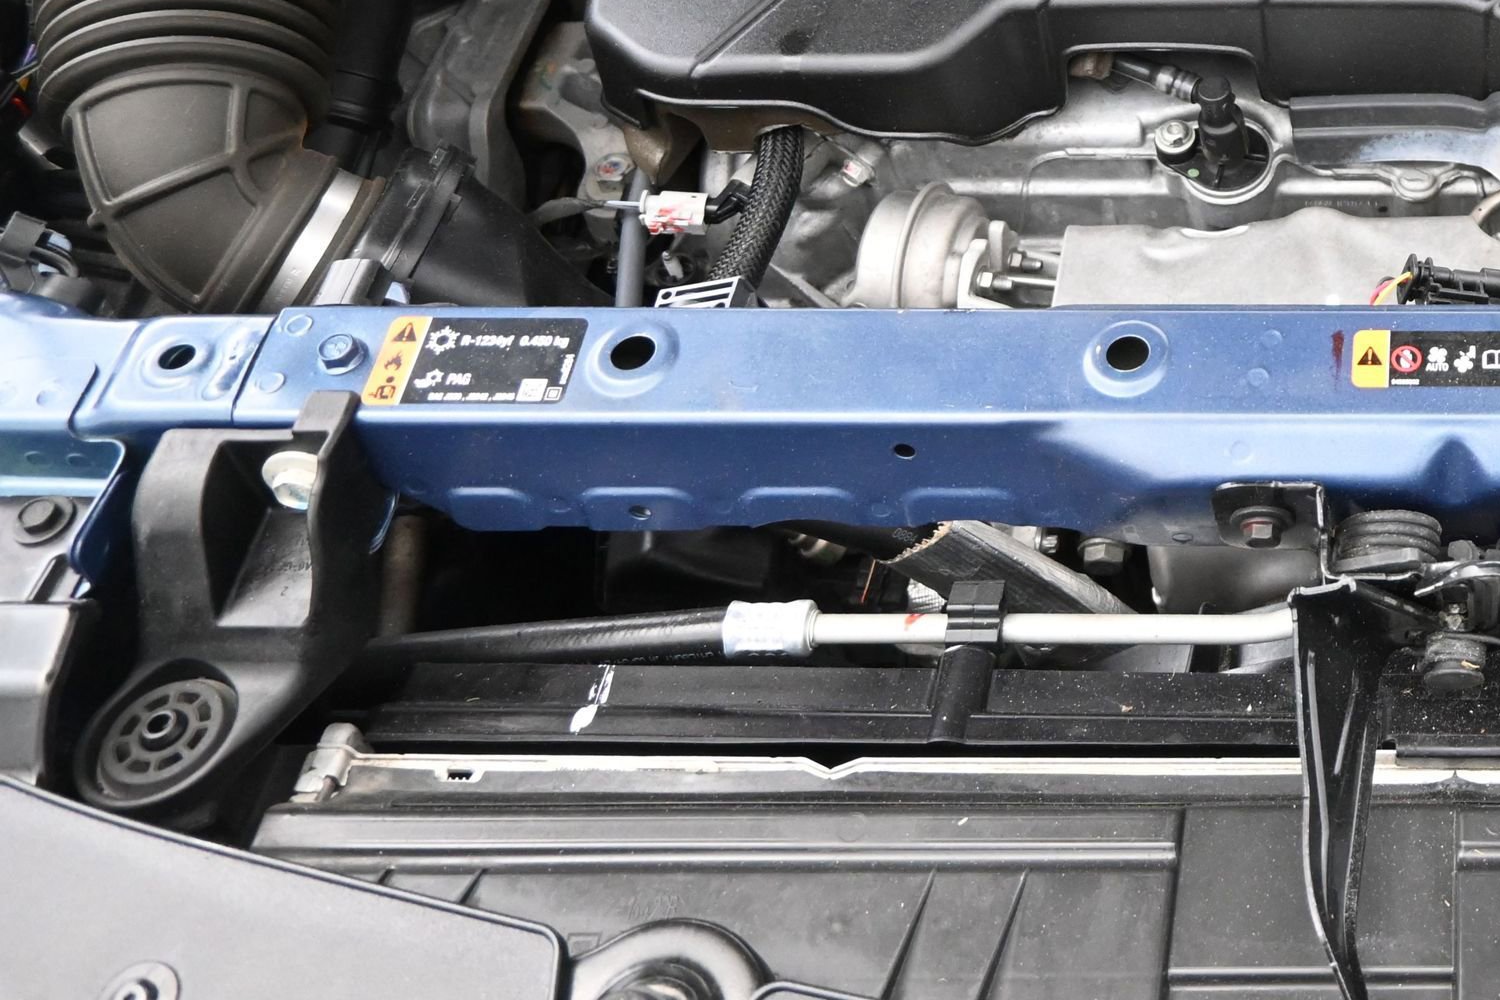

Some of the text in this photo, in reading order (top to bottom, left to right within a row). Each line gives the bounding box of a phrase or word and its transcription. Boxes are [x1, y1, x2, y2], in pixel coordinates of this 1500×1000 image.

[460, 334, 515, 348] R-1234yf
[1425, 362, 1449, 372] AUTO
[445, 373, 472, 385] PAG
